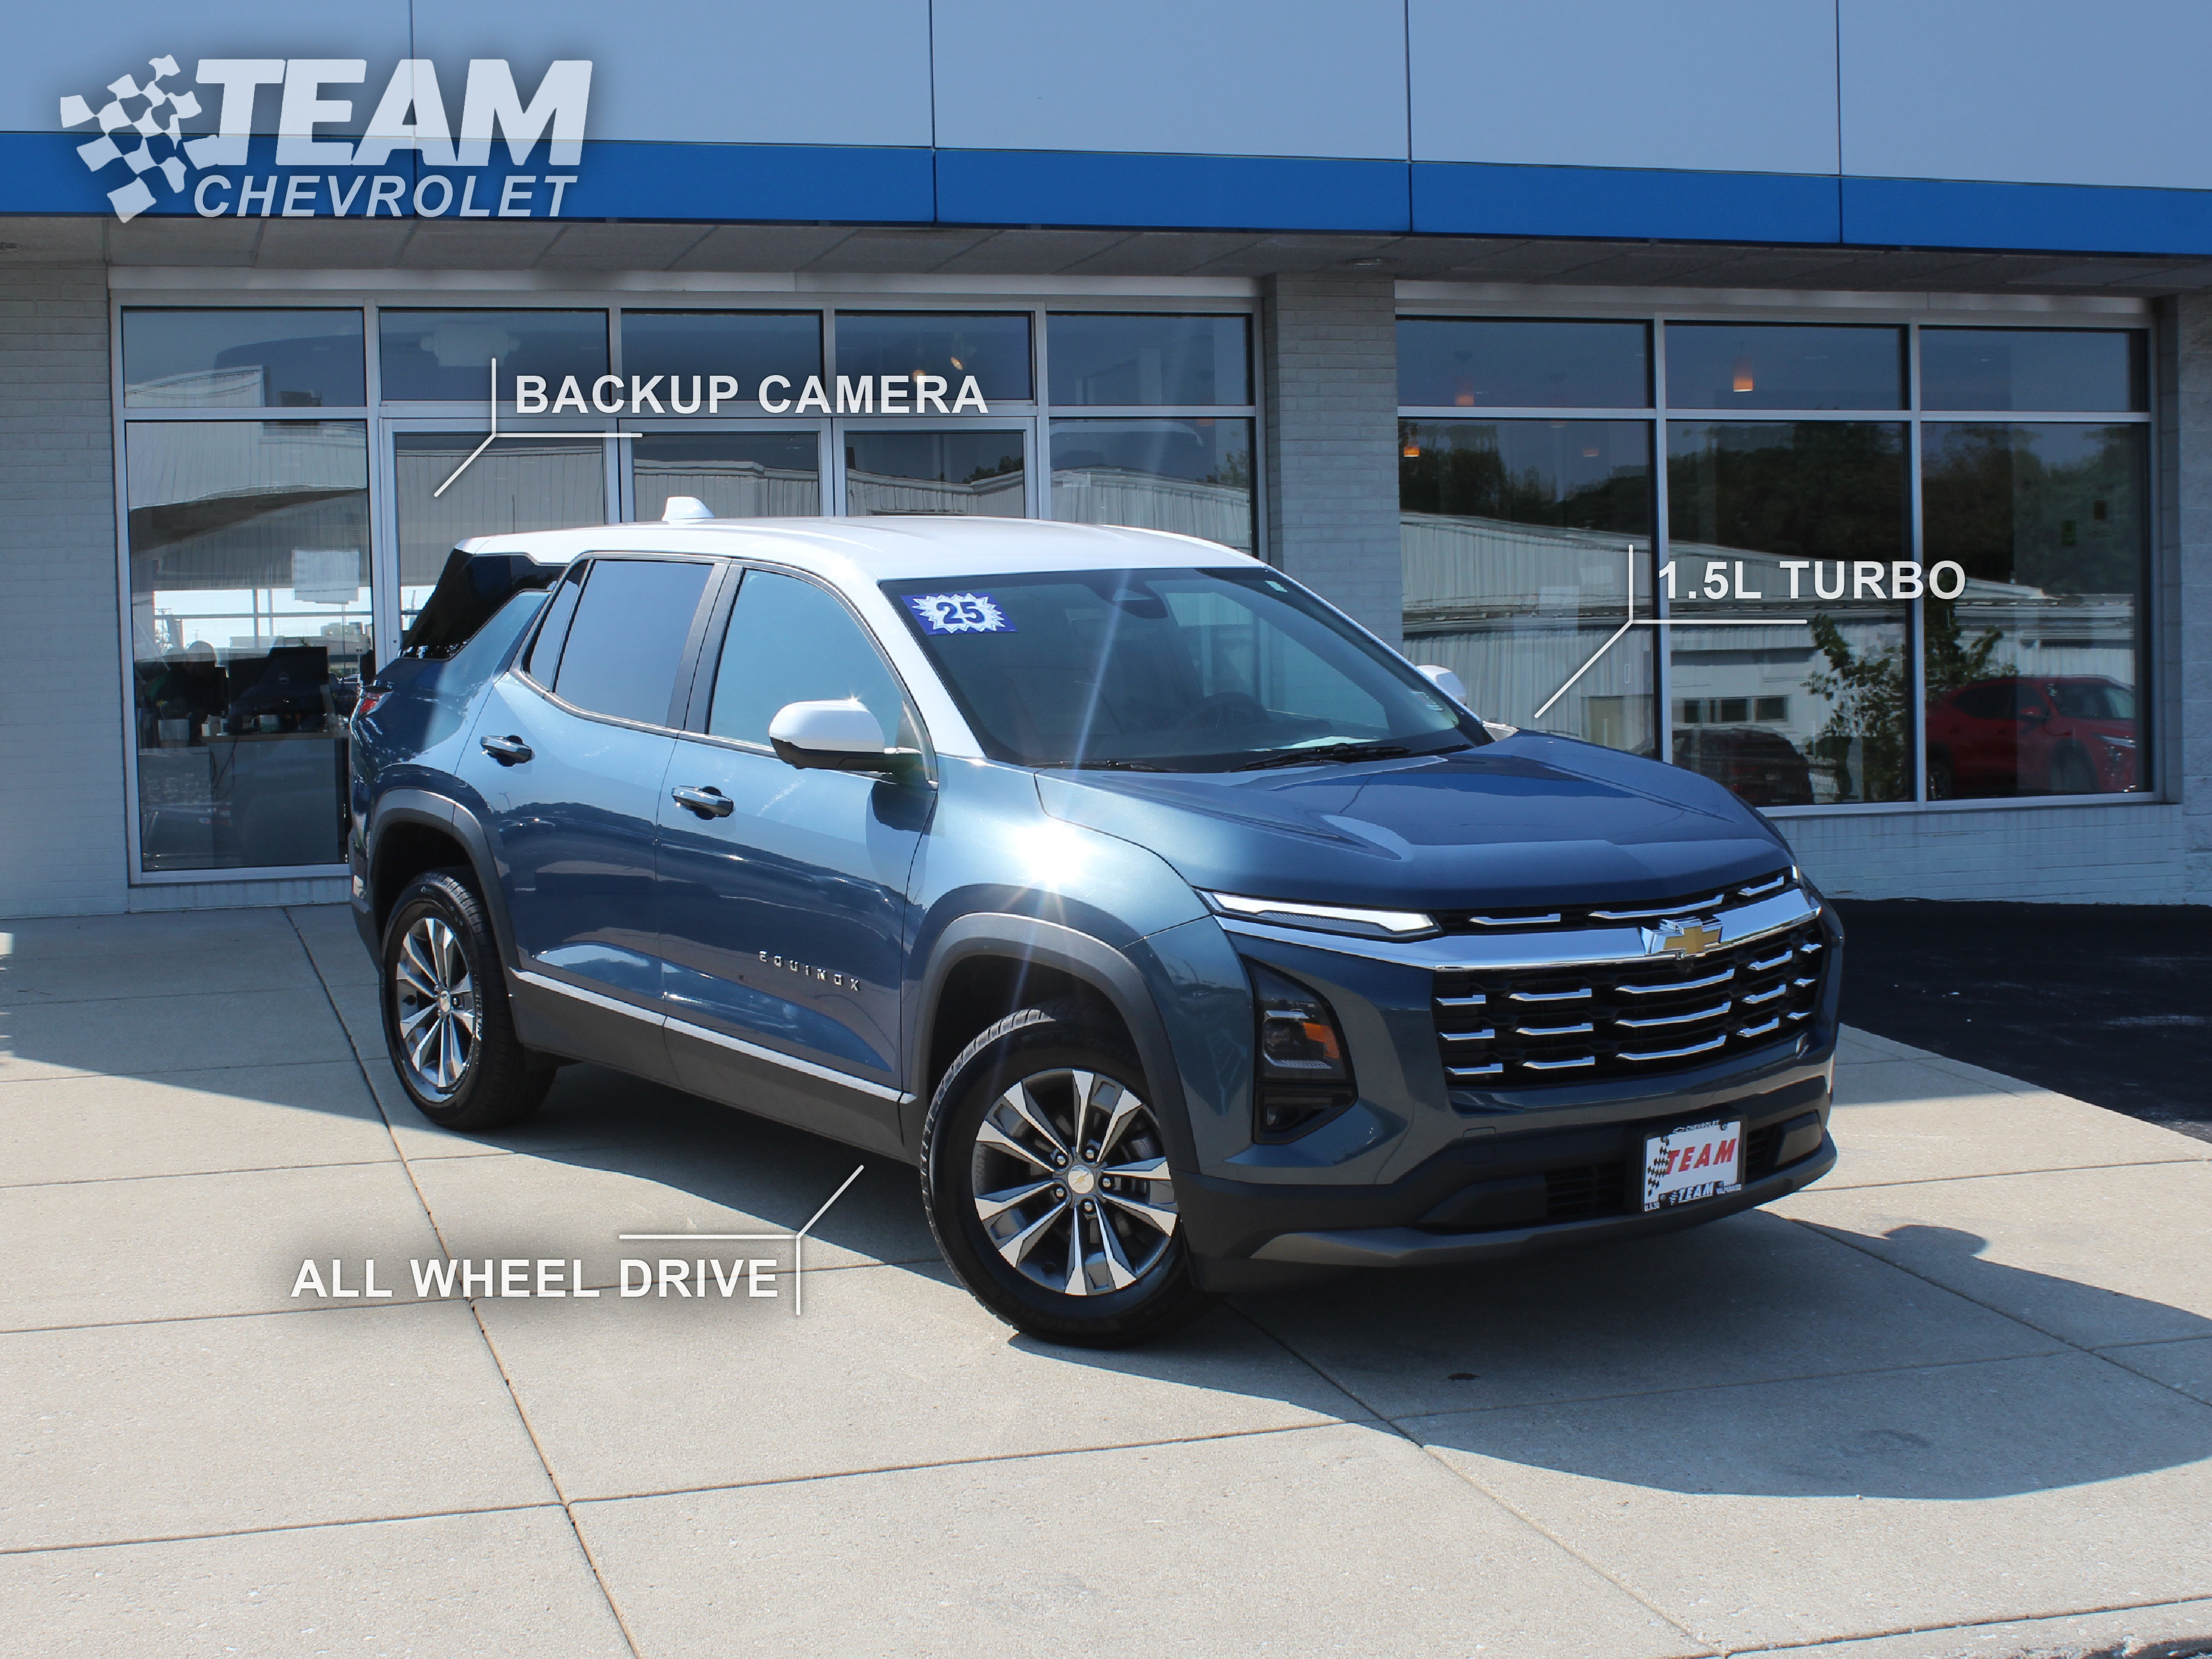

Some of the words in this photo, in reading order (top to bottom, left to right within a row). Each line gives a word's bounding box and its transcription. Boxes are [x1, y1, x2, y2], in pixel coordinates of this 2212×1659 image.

[936, 601, 985, 625] 25
[758, 950, 860, 992] EQUINOX
[1665, 1138, 1736, 1175] TEAM
[1678, 1182, 1714, 1203] TEAM
